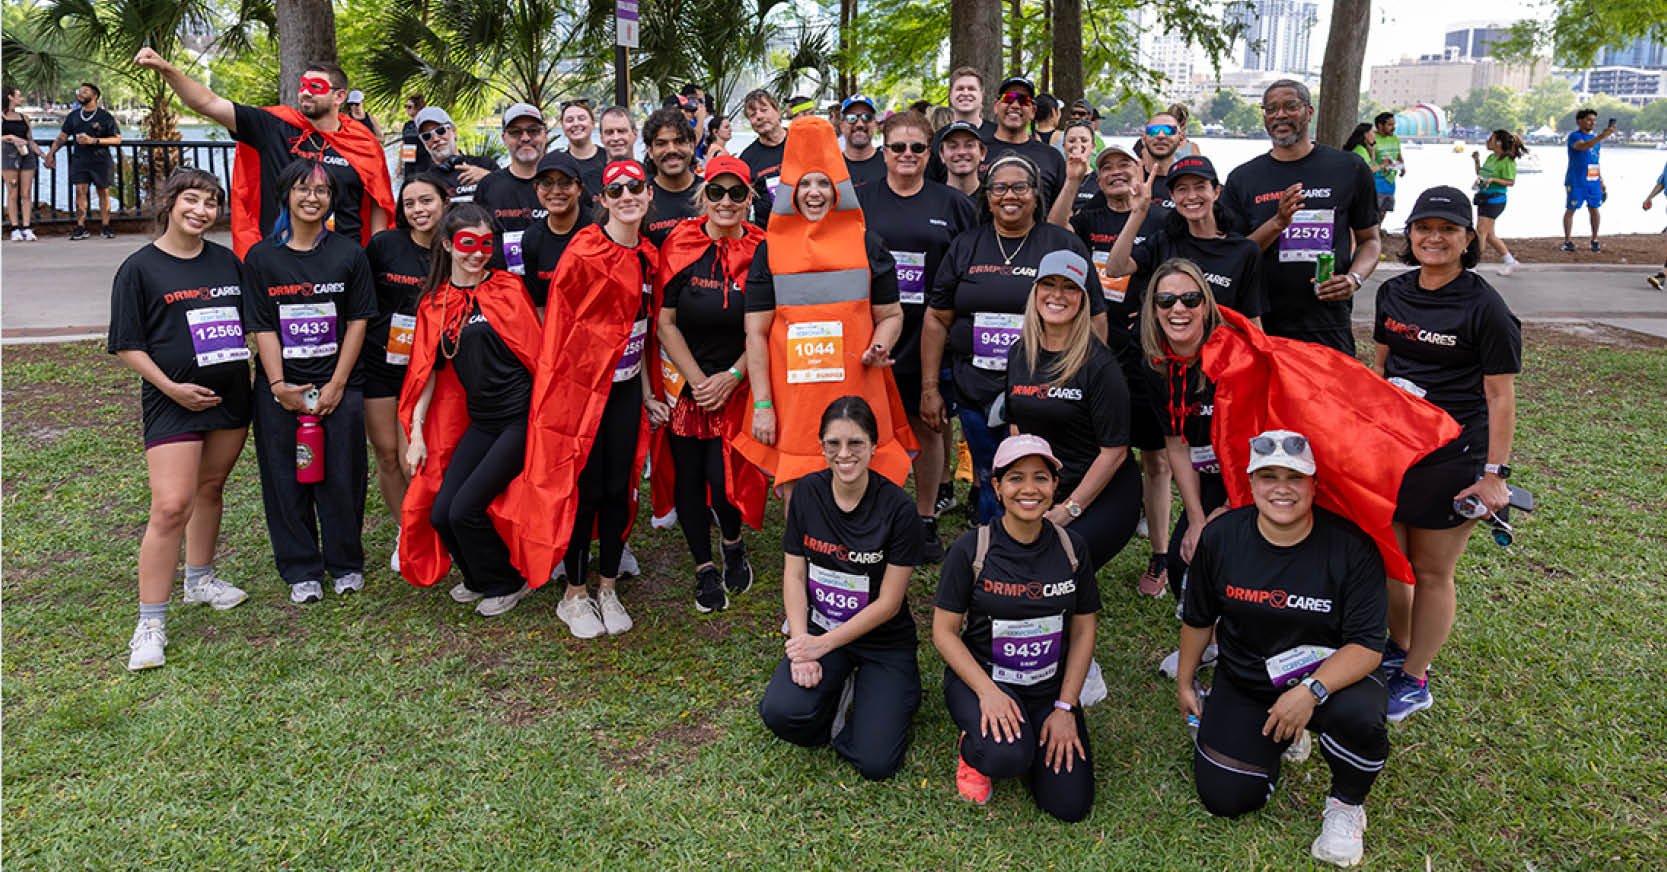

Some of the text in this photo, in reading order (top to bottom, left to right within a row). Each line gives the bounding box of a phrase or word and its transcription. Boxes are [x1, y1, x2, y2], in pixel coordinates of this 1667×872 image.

[1299, 188, 1332, 198] CARES
[1282, 227, 1330, 239] 12573
[897, 269, 923, 281] 567
[164, 285, 241, 304] DRMP CARES
[268, 282, 345, 297] DRMP CARES
[196, 324, 243, 340] 12560
[289, 321, 330, 335] 9433
[1418, 329, 1457, 346] CARES
[795, 341, 836, 357] 1044
[1048, 386, 1083, 400] CARES
[848, 549, 884, 564] CARES
[984, 579, 1076, 597] DRMP CARES
[815, 588, 858, 609] 9436
[1226, 584, 1333, 613] DRMP CARES
[1003, 639, 1053, 658] 9437
